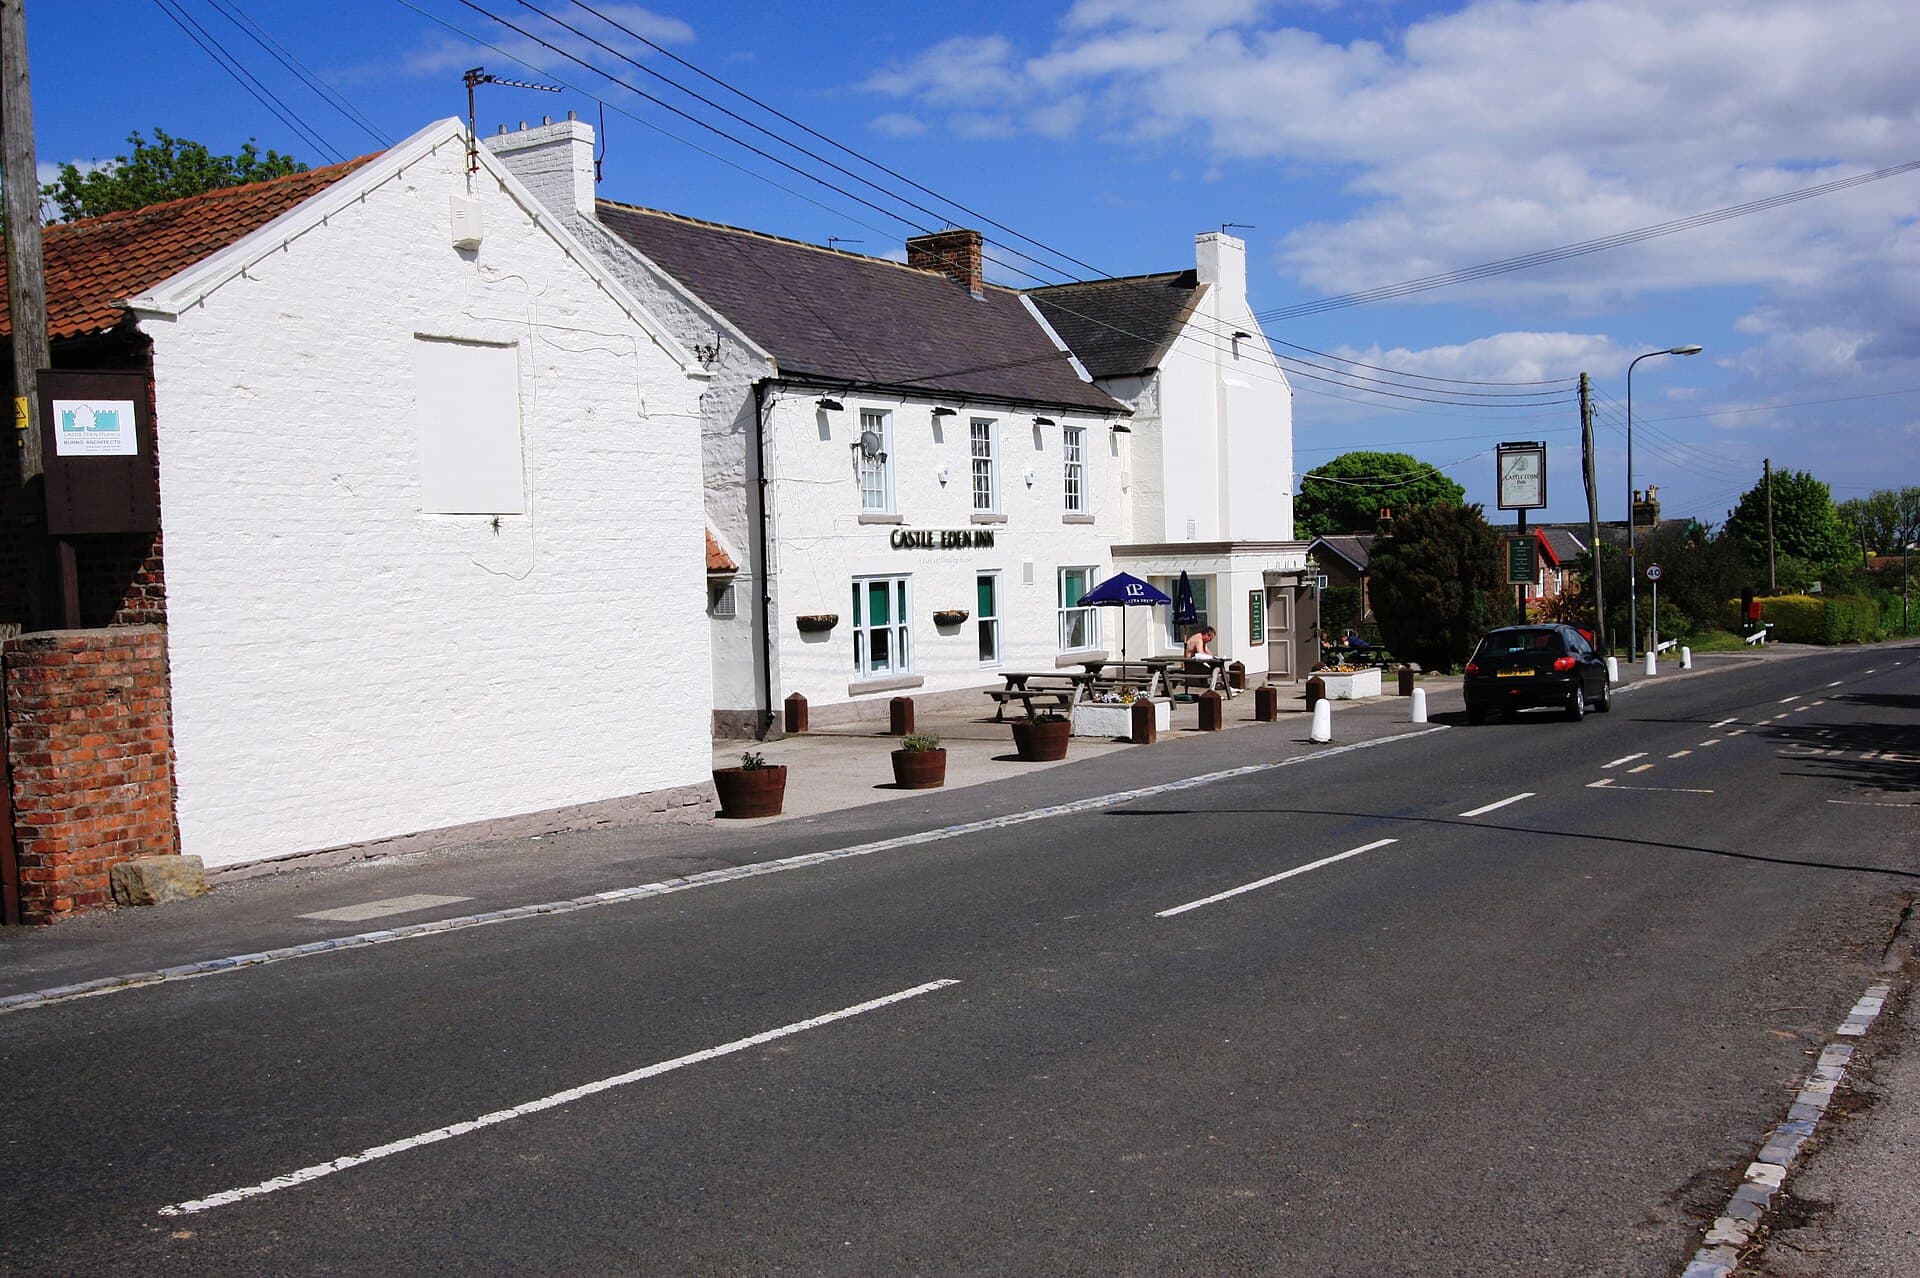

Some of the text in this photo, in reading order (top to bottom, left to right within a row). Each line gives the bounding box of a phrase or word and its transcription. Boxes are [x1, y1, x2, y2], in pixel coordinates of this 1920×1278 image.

[890, 529, 995, 550] CASTLE EDEN INN
